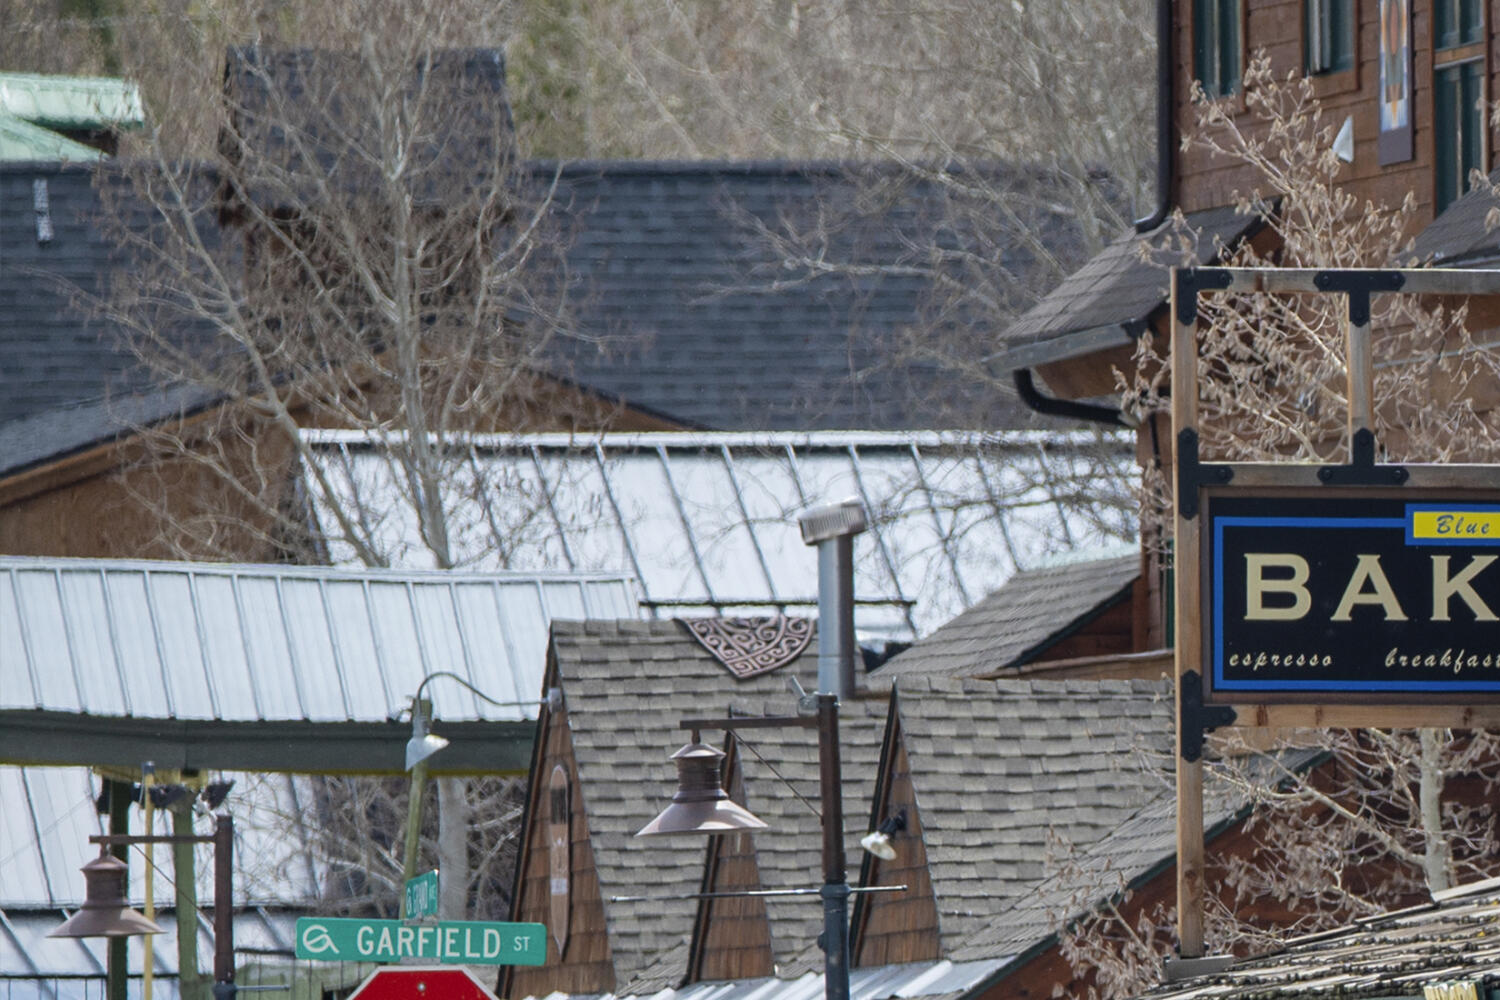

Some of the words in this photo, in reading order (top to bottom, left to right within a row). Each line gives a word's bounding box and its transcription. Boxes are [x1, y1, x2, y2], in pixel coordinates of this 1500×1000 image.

[1436, 509, 1490, 534] Blue
[1229, 652, 1333, 671] espresso
[357, 926, 500, 958] GARFIELD
[513, 936, 530, 951] ST
